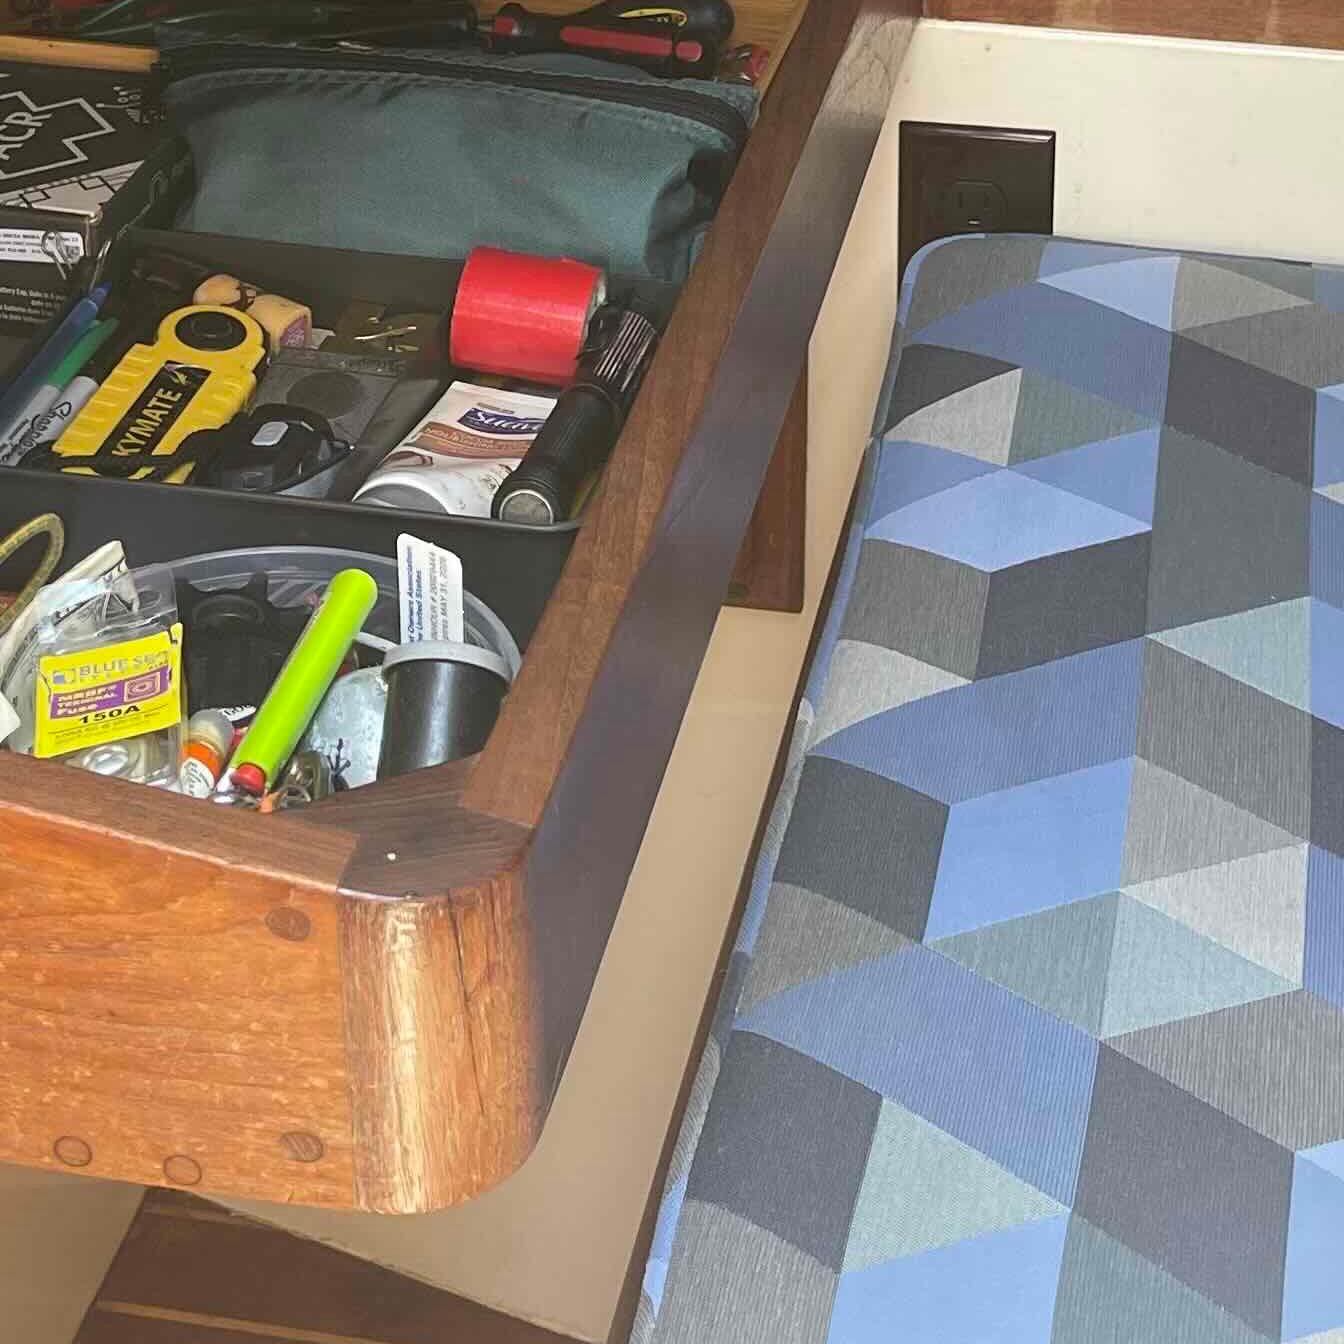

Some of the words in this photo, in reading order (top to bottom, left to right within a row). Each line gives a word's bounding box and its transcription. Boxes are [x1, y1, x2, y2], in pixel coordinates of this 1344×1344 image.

[415, 569, 423, 599] States
[79, 658, 129, 679] BLUE
[79, 704, 141, 724] 150A
